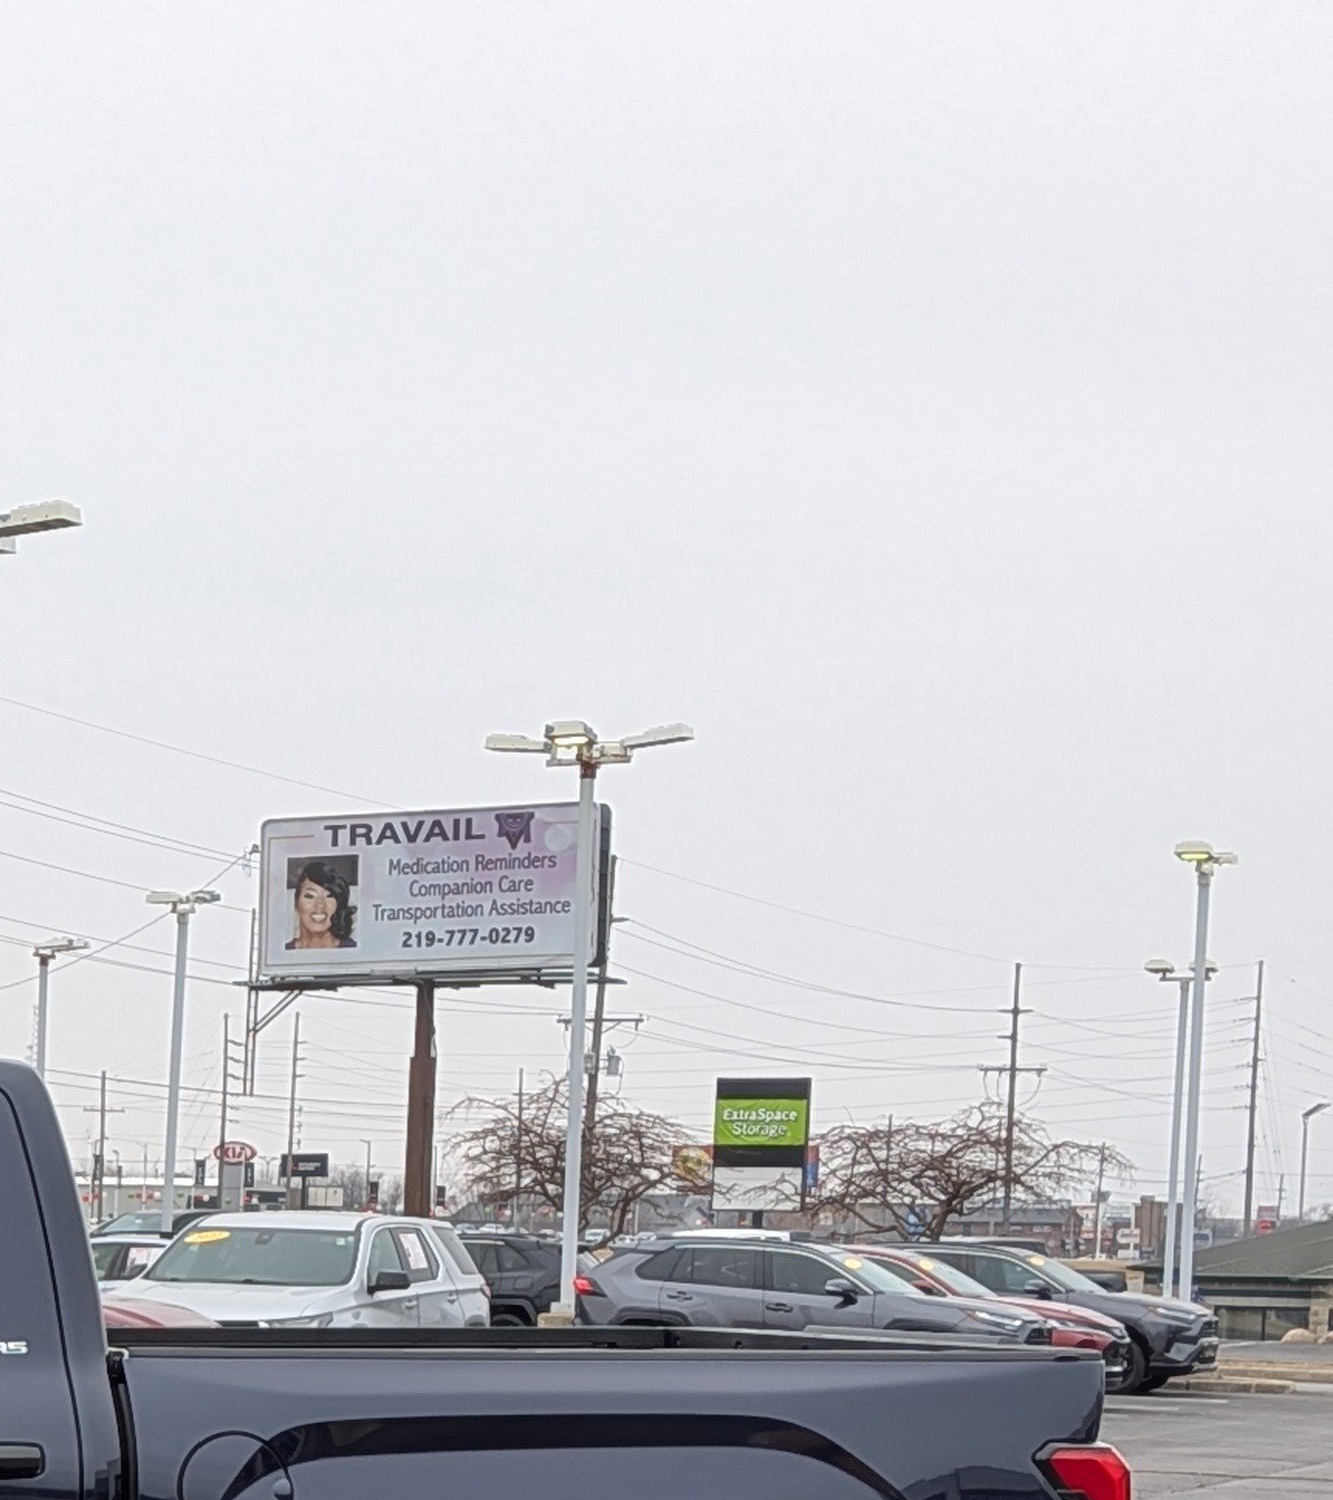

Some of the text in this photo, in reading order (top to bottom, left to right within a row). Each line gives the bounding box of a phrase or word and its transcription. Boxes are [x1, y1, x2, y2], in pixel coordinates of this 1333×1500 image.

[323, 817, 486, 847] TRAVAIL
[388, 852, 557, 876] Medication Reminders
[408, 875, 534, 900] Companion Care
[371, 899, 572, 925] Transportation Assistance
[401, 925, 536, 949] 219-777-0279
[732, 1121, 788, 1138] Storage
